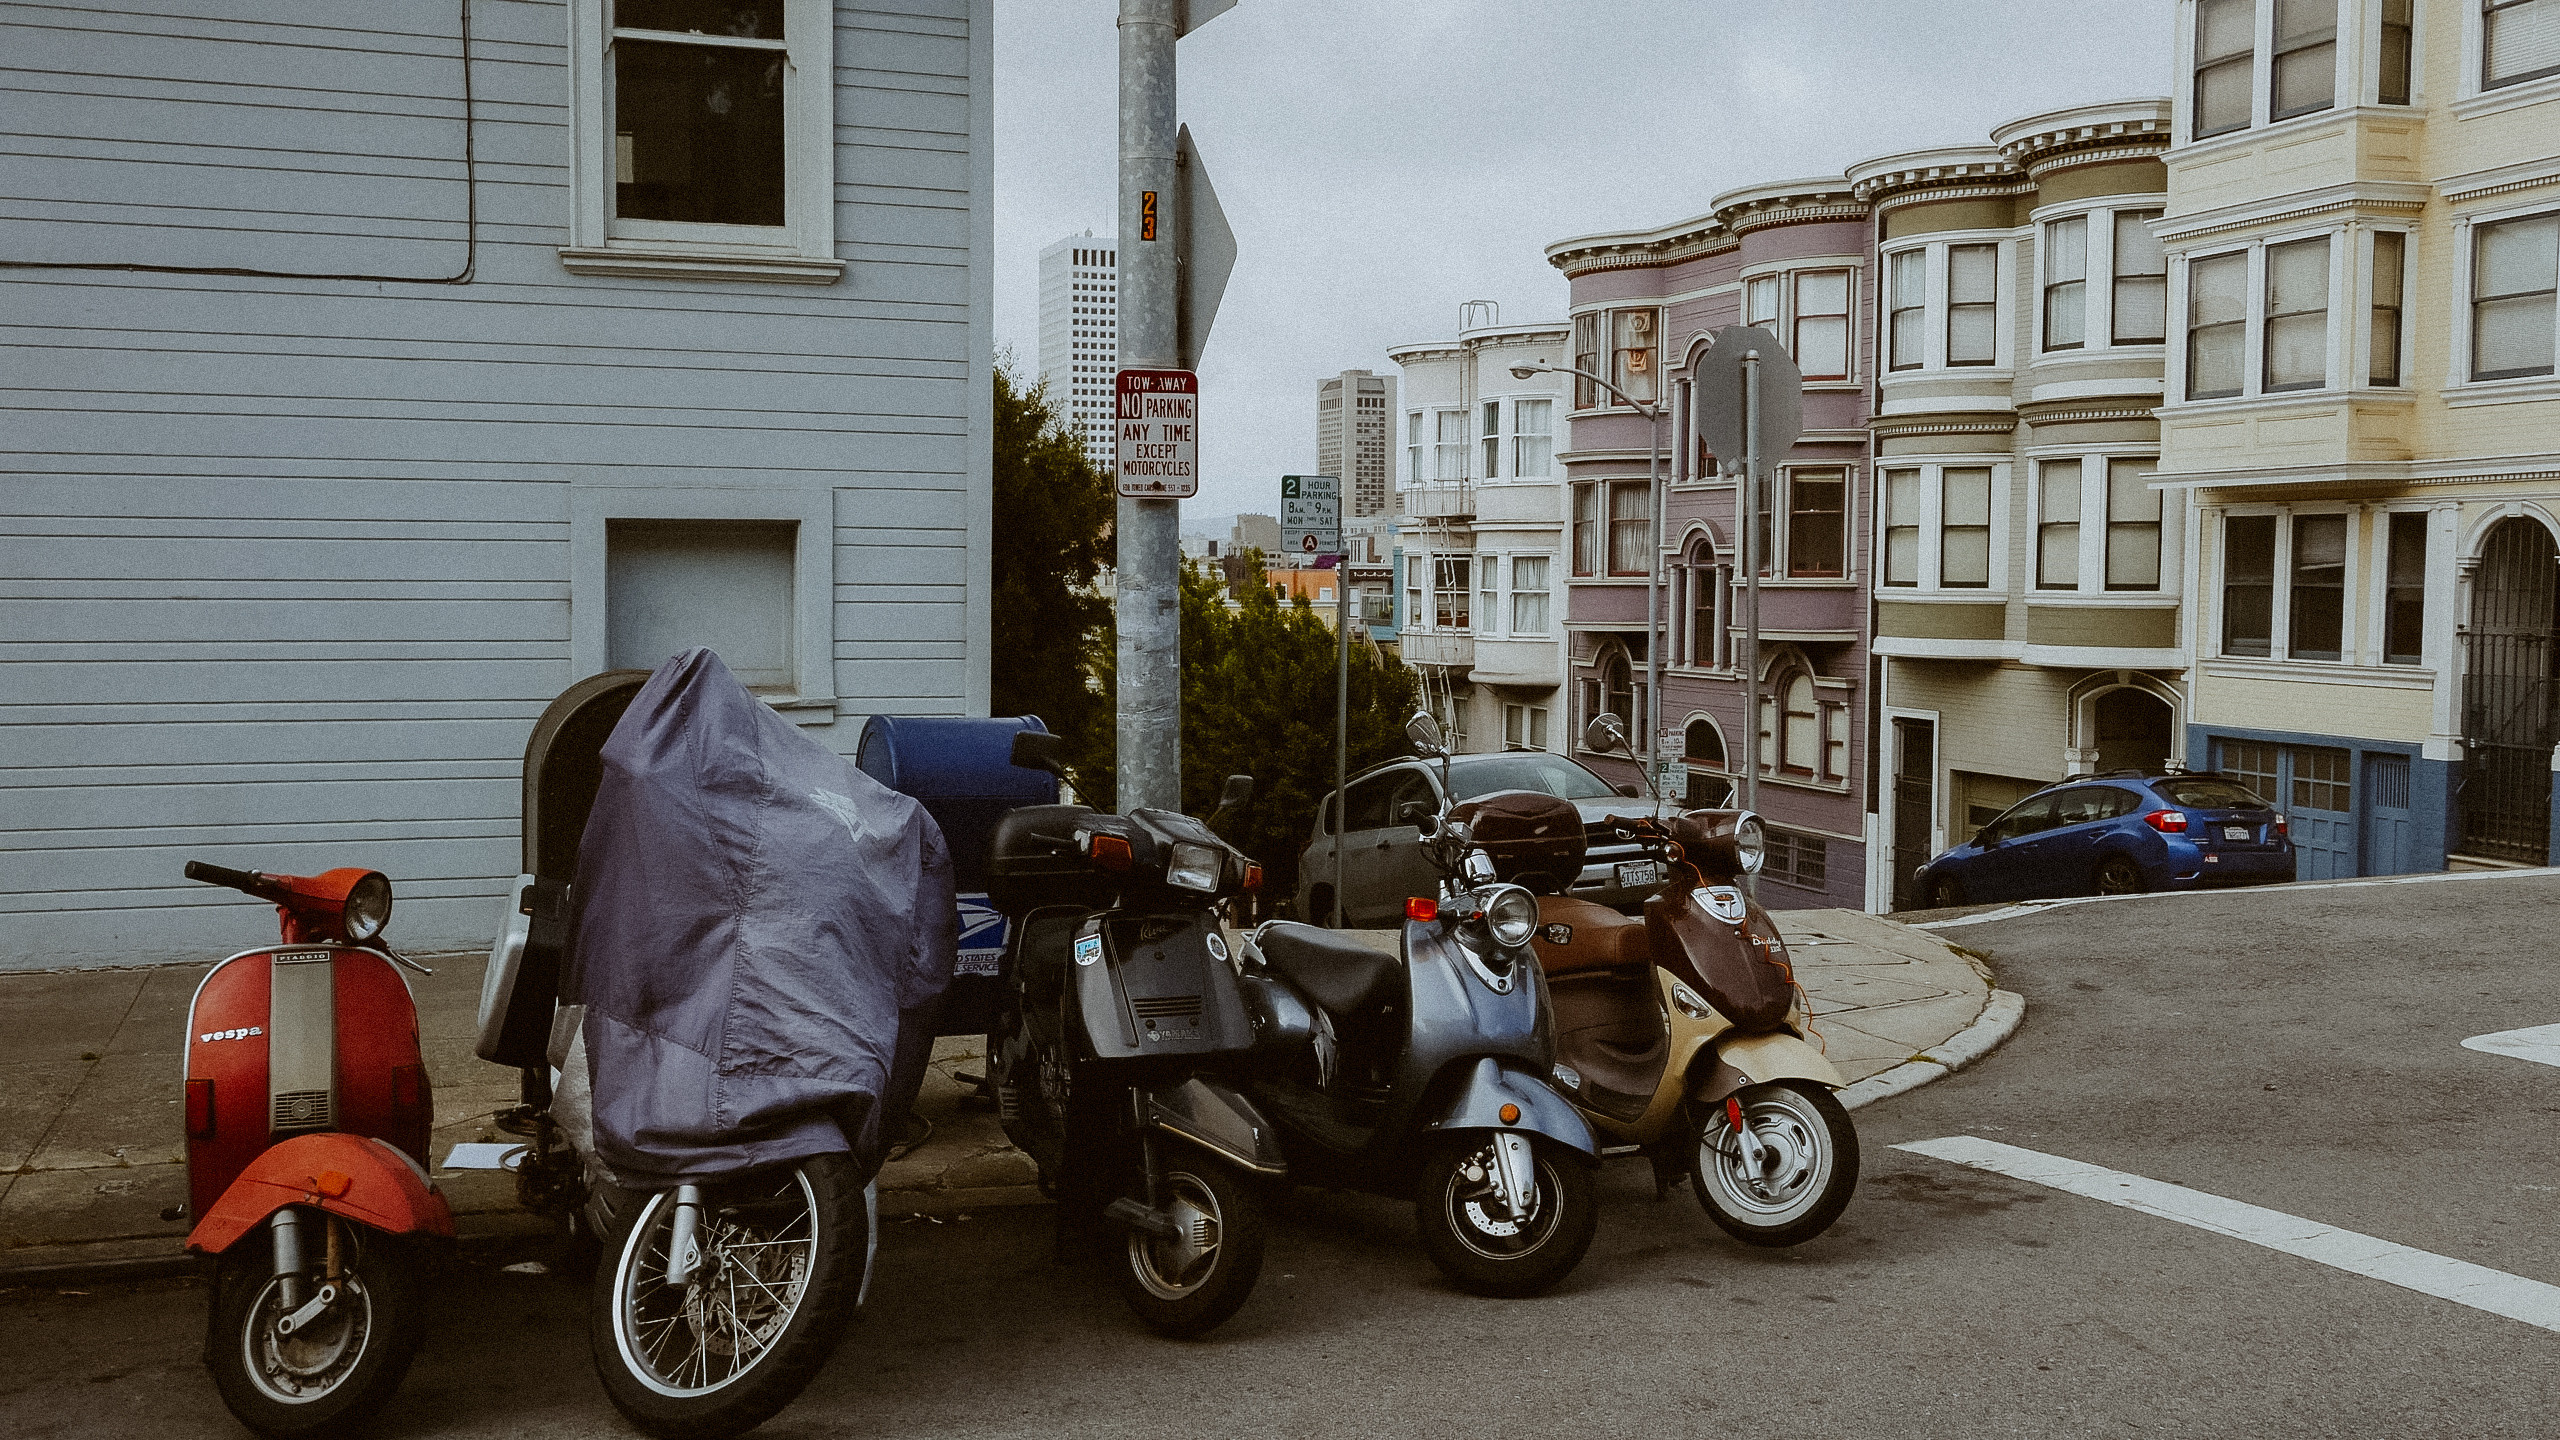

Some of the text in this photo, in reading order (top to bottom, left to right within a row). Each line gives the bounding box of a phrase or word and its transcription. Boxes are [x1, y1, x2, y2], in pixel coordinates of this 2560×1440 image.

[1121, 392, 1192, 419] NO PARKING
[1123, 423, 1192, 442] ANY TIME
[1136, 443, 1178, 459] EXCEPT
[1123, 460, 1190, 476] MOTORCYCLES
[1286, 479, 1331, 495] 2 HOUR
[1301, 490, 1337, 500] PARKING
[1287, 516, 1303, 525] MON
[1319, 517, 1333, 526] SAT
[1305, 536, 1315, 548] A
[1661, 764, 1668, 772] 2
[200, 1026, 262, 1043] vespa
